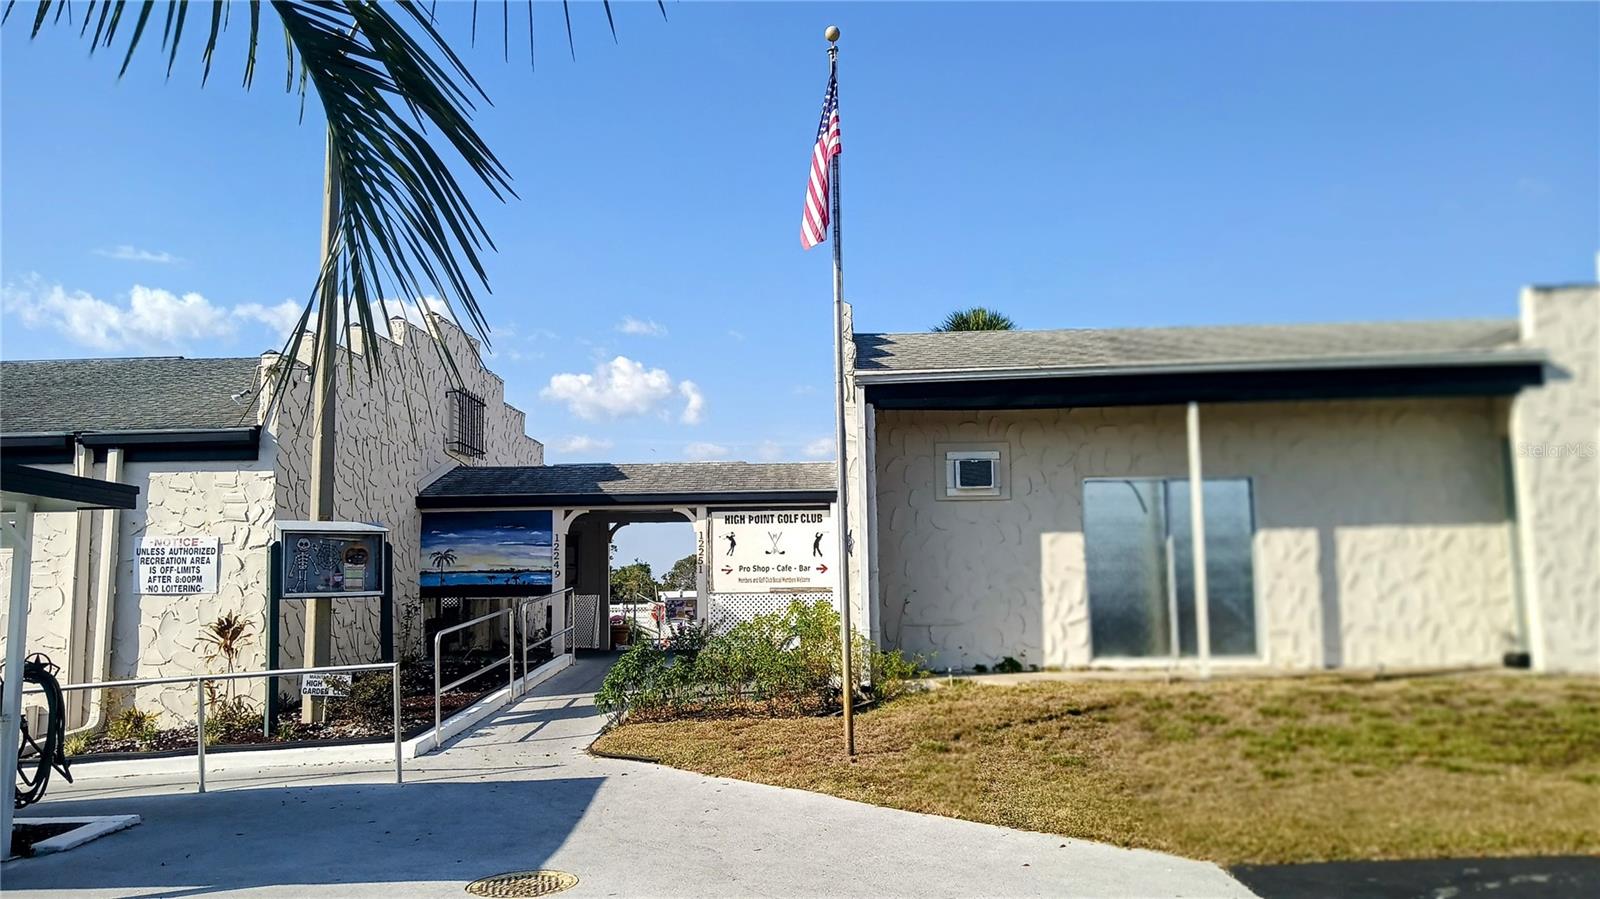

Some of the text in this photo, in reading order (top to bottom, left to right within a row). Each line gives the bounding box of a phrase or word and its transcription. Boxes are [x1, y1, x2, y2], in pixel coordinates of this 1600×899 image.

[724, 513, 823, 524] HIGH POINT GOLF CLUB
[136, 547, 216, 556] UNLESS AUTHORIZED
[553, 533, 561, 579] 12249
[140, 557, 211, 565] RECREATION AREA
[149, 566, 201, 574] IS OFF-LIMITS
[752, 565, 770, 573] Shop
[776, 564, 792, 572] Cafe
[798, 564, 811, 572] Bar
[147, 575, 203, 583] AFTER 8:00PM
[302, 687, 330, 695] GARDEN
